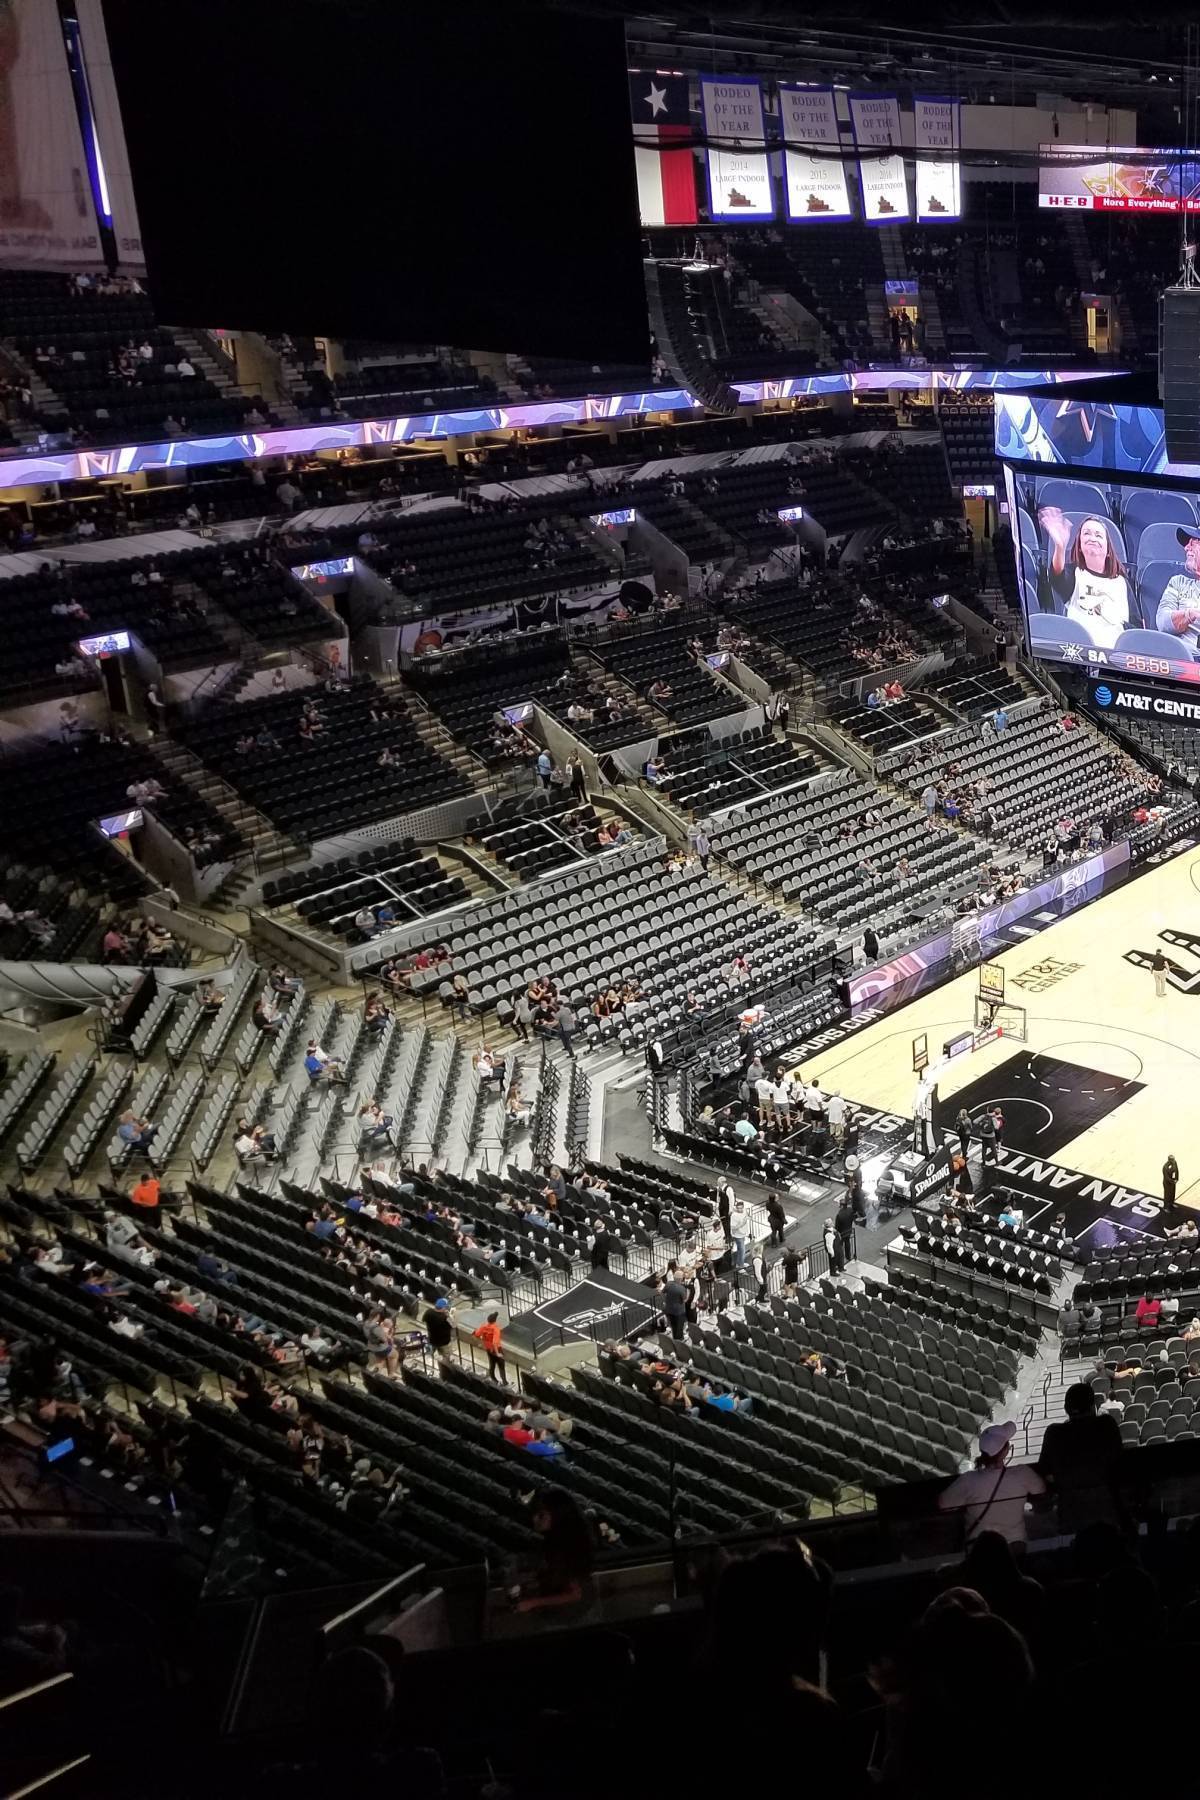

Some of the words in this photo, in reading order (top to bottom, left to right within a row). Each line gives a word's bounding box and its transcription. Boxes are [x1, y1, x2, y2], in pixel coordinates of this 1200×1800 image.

[714, 87, 751, 98] RODEO
[791, 96, 826, 106] RODEO
[714, 103, 726, 114] OF
[731, 105, 754, 114] THE
[860, 103, 891, 113] RODEO
[923, 106, 952, 116] RODEO
[792, 112, 806, 121] OF
[808, 112, 830, 122] THE
[720, 122, 750, 131] YEAR
[862, 119, 877, 129] OF
[877, 119, 895, 128] THE
[922, 121, 934, 130] OF
[936, 121, 953, 130] THE
[800, 129, 826, 138] YEAR
[928, 135, 949, 145] YEAR
[731, 161, 748, 170] 2014
[809, 170, 827, 179] 2015
[1103, 198, 1125, 207] Here
[1087, 650, 1107, 664] SA
[1126, 655, 1170, 674] 25:59
[1115, 692, 1152, 711] AT&T
[1008, 957, 1066, 989] AT&T
[1028, 962, 1085, 993] CENTER
[779, 1007, 885, 1063] SPURS.COM
[915, 1163, 950, 1197] SPALDING
[1078, 1180, 1165, 1218] SAN
